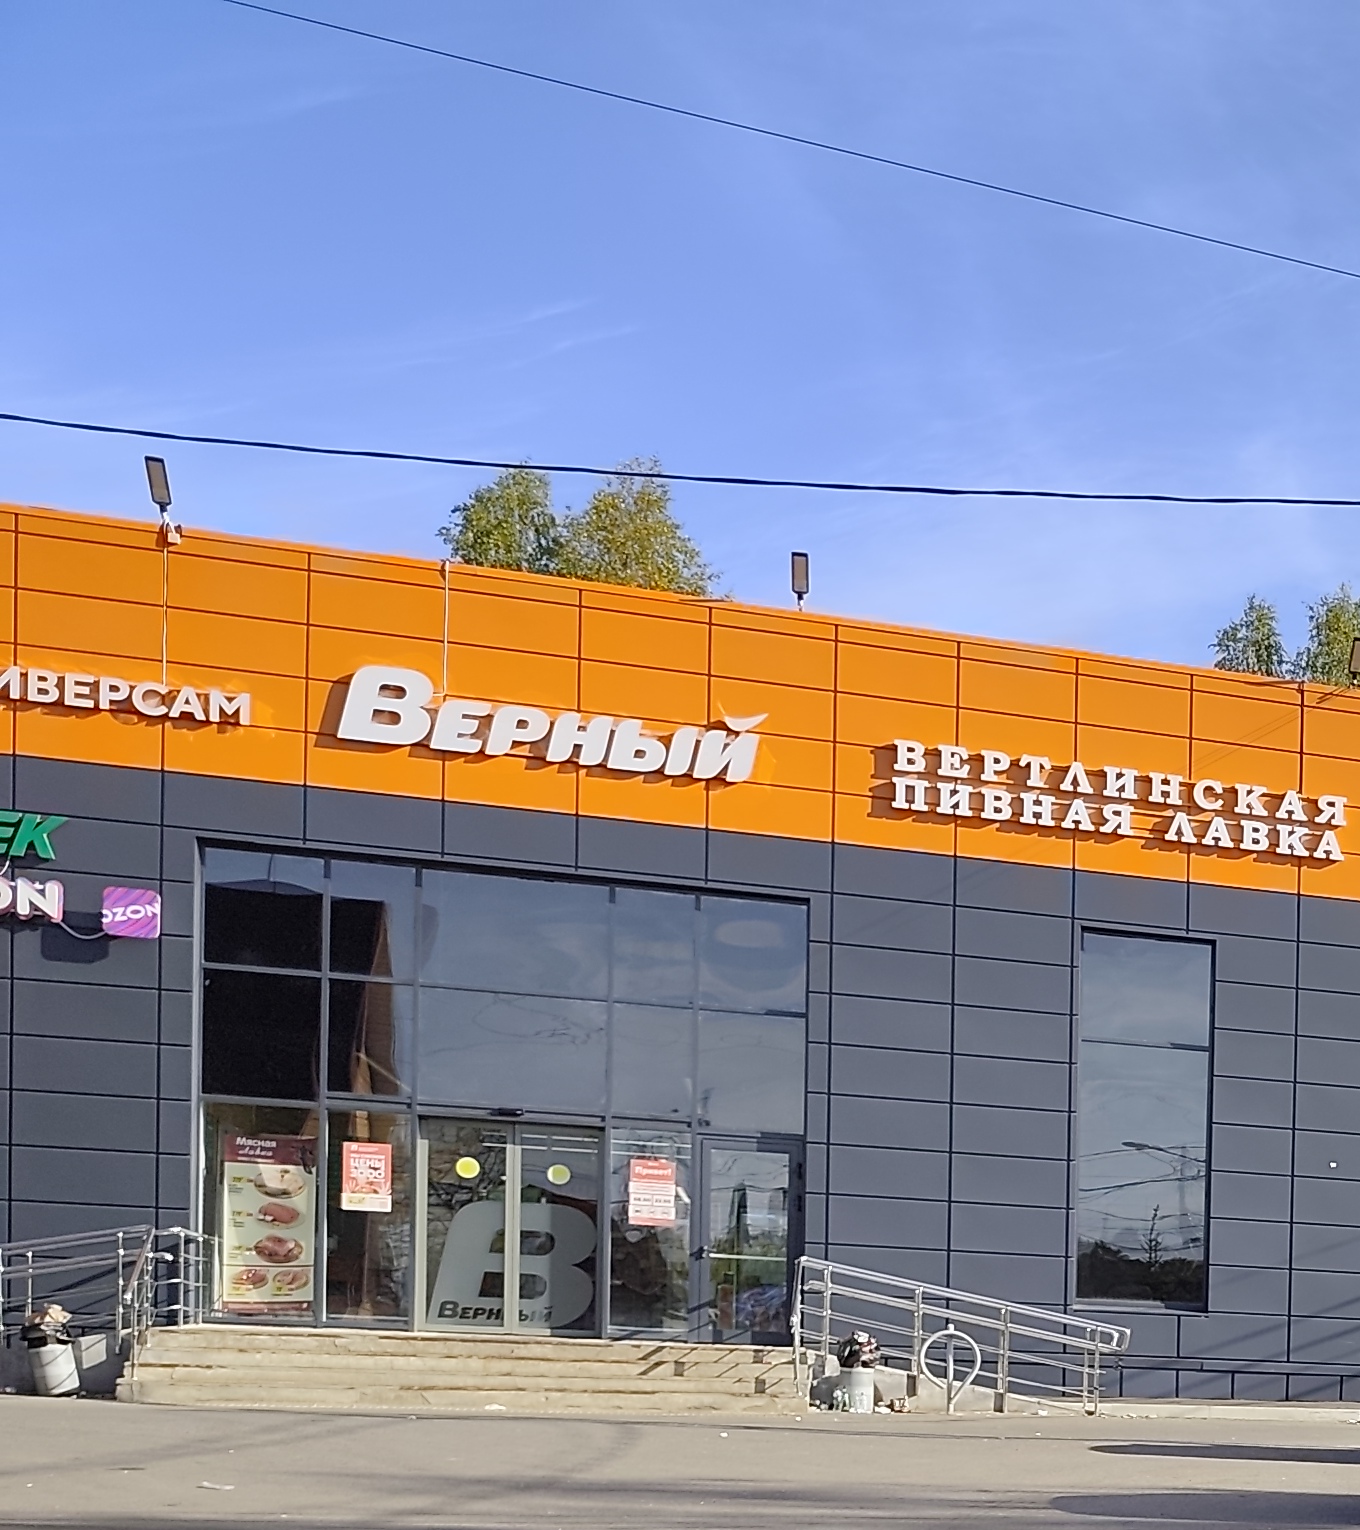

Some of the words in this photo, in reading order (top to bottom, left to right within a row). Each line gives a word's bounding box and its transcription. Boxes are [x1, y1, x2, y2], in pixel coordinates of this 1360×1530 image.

[892, 738, 1347, 826] ВЕРТЛИНСКАЯ
[891, 776, 1134, 836] ПИВНАЯ
[1165, 817, 1345, 862] ЛАВКА
[350, 1158, 385, 1171] ЦЕНЫ
[634, 1166, 672, 1176] Привет!
